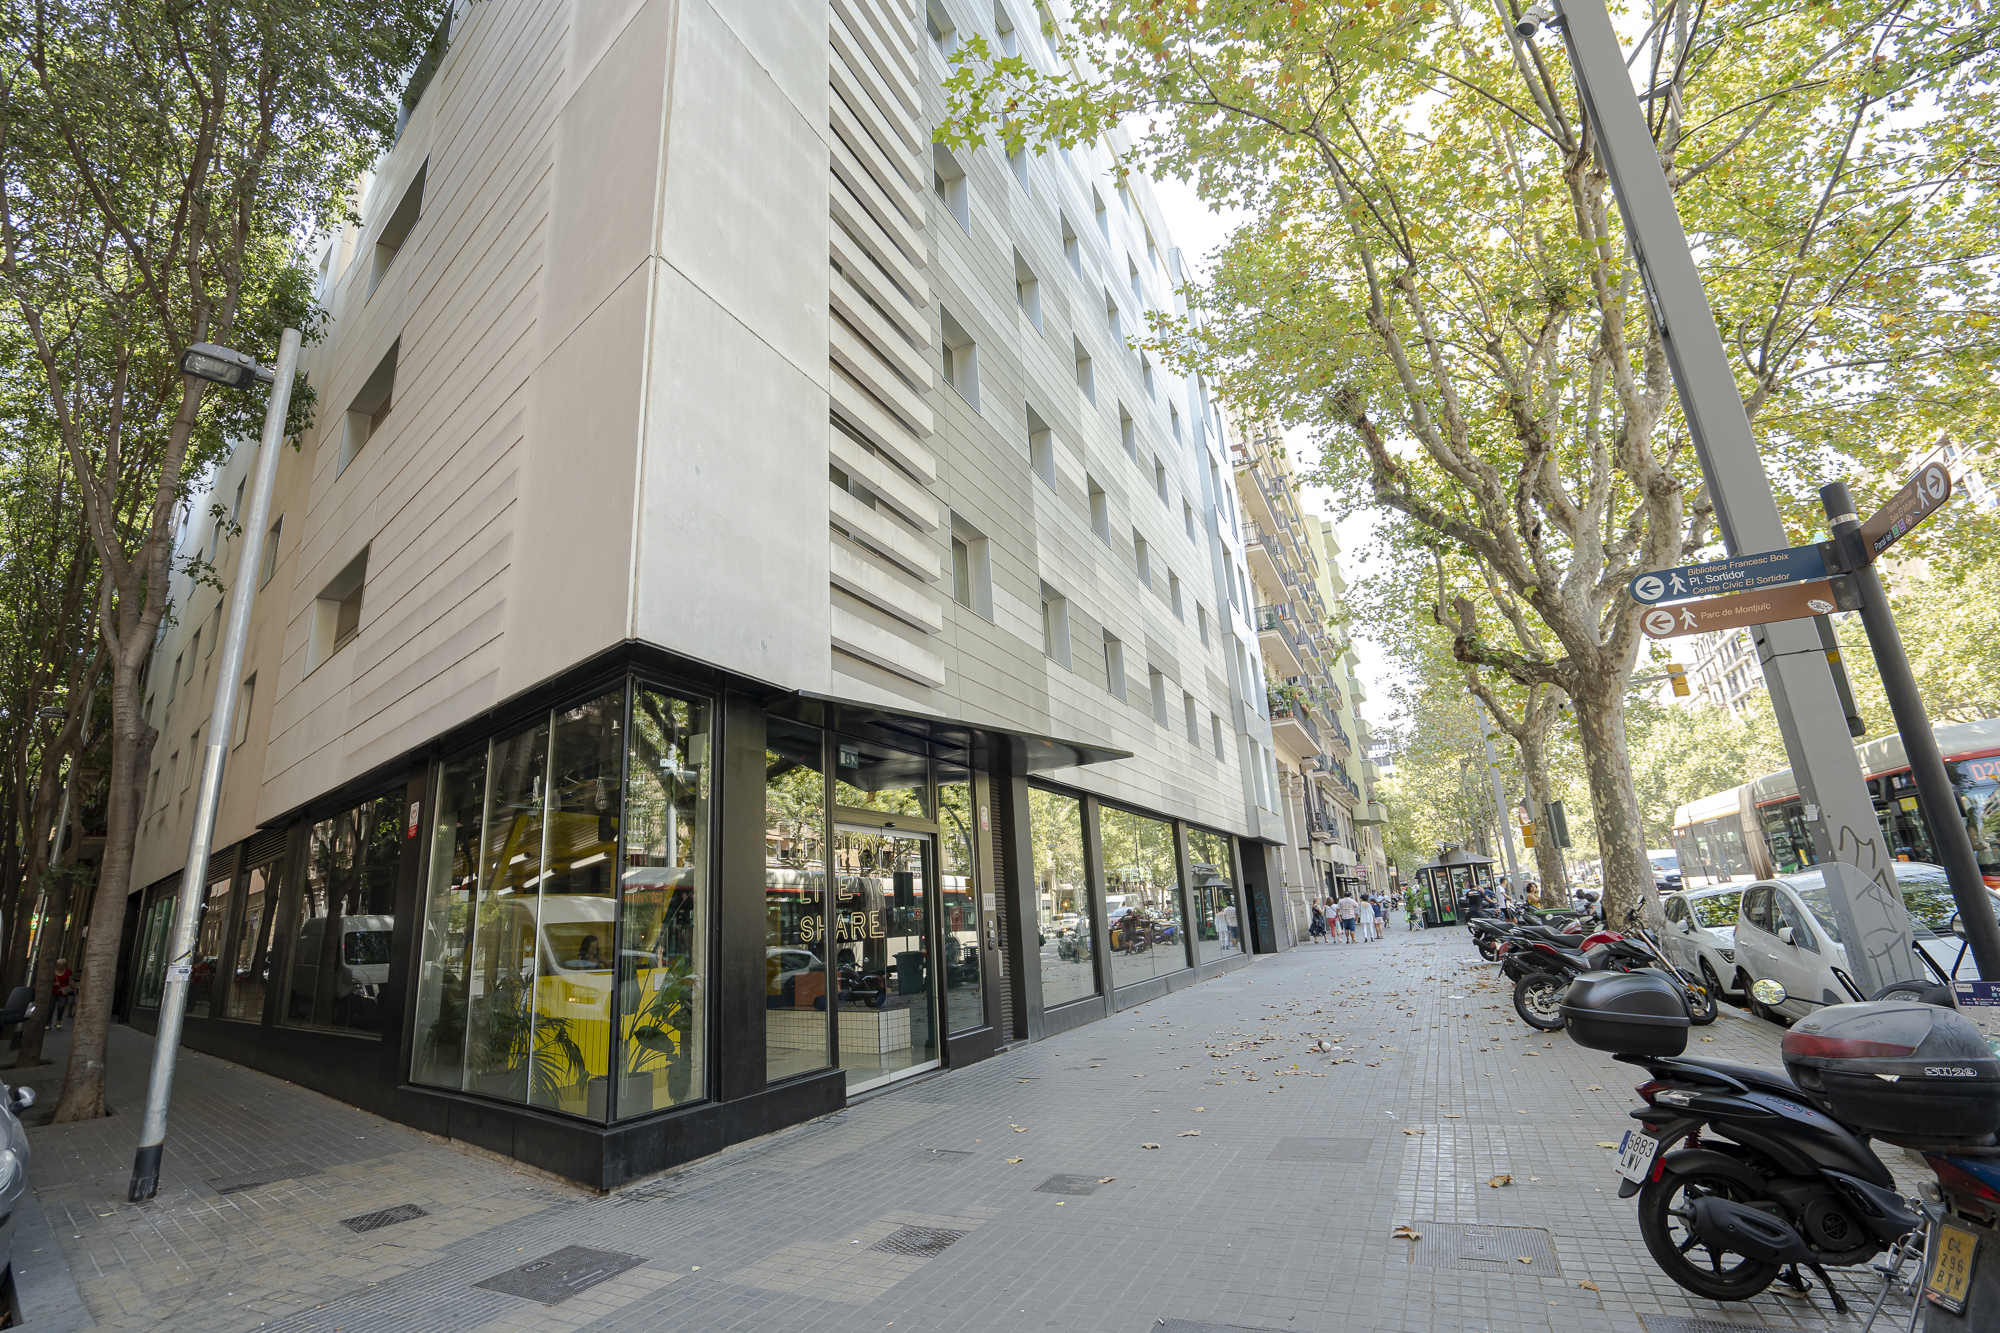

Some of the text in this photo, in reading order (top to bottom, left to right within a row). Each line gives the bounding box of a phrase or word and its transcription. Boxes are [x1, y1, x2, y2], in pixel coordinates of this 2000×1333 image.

[1890, 512, 1900, 524] Sala
[1903, 497, 1917, 513] Molino
[1687, 552, 1789, 576] Biblioteca Francesc Boix
[1689, 569, 1745, 586] Pl. Sortidor
[1692, 584, 1720, 595] Centre
[1745, 578, 1754, 586] El
[1756, 573, 1790, 585] Sortidor
[1701, 602, 1771, 620] Parc de Montjuïc
[985, 896, 995, 907] 101
[800, 910, 885, 942] SHARE
[1924, 1066, 1977, 1077] SH29
[1627, 1133, 1655, 1158] 5883
[1621, 1150, 1643, 1172] LWV
[1941, 1253, 1964, 1273] 296
